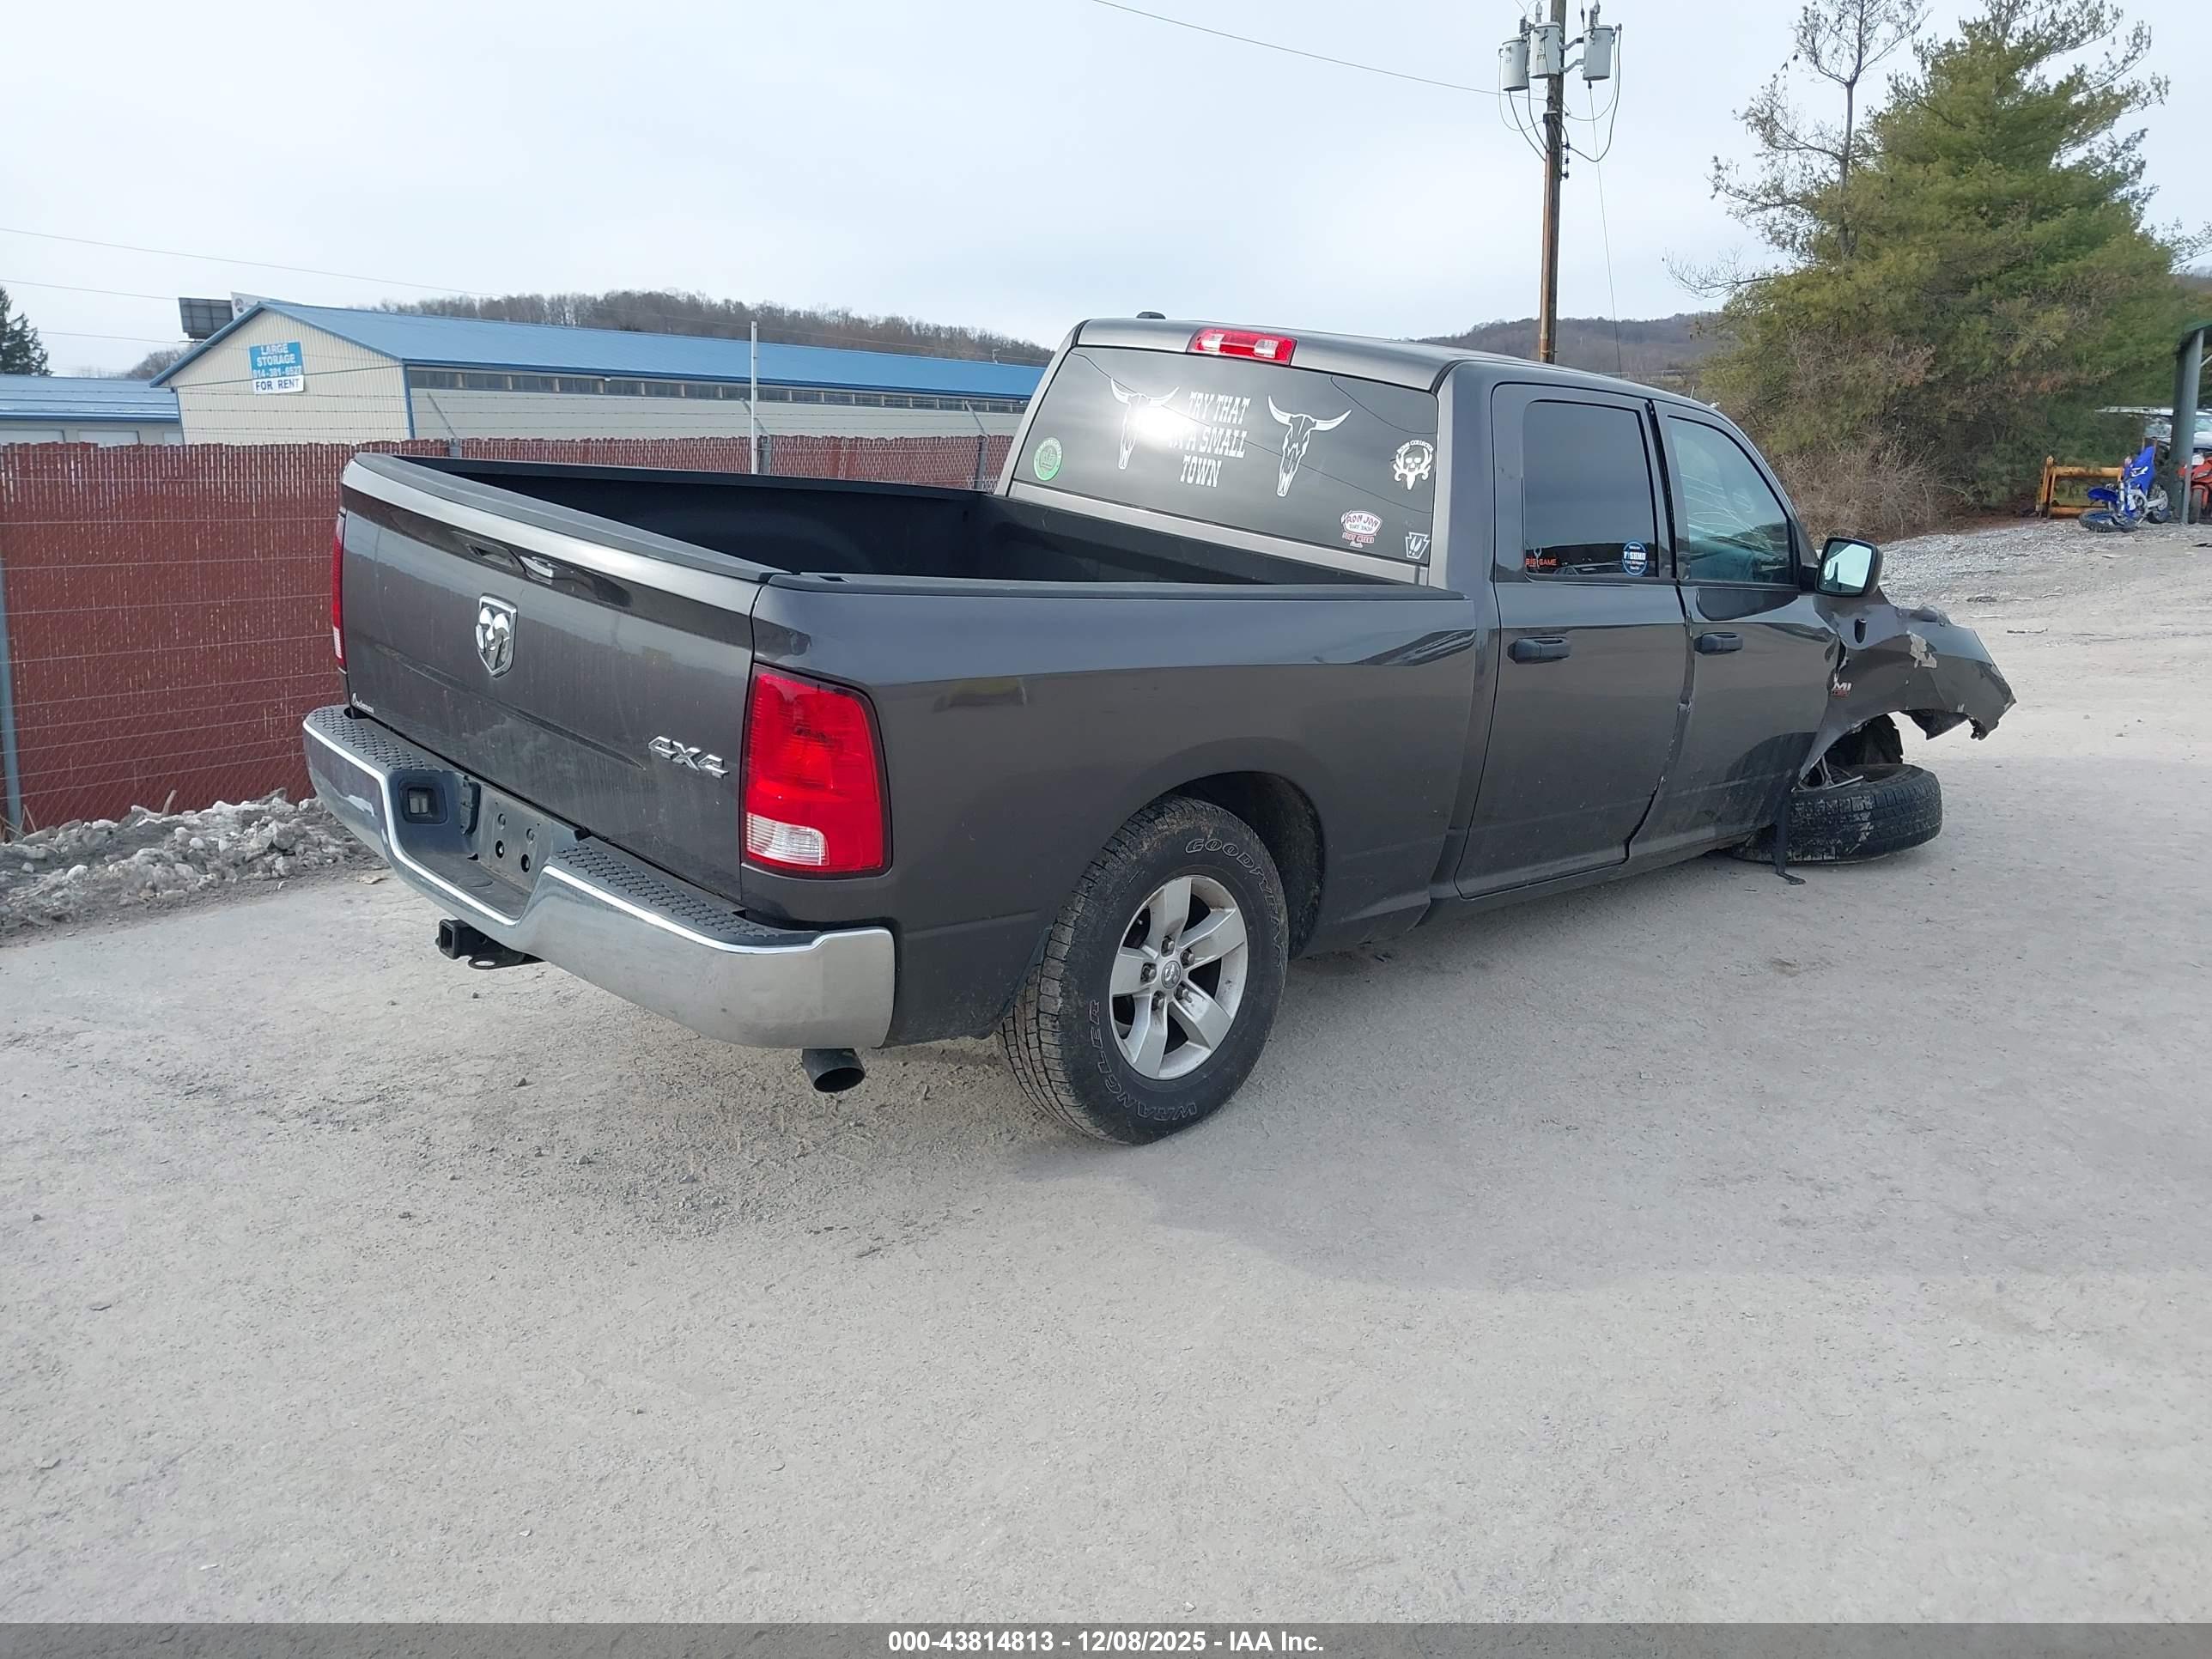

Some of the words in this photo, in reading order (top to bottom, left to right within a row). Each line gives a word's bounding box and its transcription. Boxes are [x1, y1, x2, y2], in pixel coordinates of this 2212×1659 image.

[257, 354, 295, 367] STORAGE
[260, 343, 289, 356] LARGE
[255, 380, 273, 391] FOR
[277, 379, 301, 390] RENT
[1188, 391, 1214, 421] TRY
[1213, 394, 1251, 425] THAT
[1186, 431, 1197, 451] A
[1199, 426, 1248, 459] SMALL
[1180, 454, 1222, 488] TOWN
[1346, 514, 1364, 525] RON
[647, 735, 730, 778] 4X4
[1185, 838, 1286, 975] GOODYEAR
[1089, 999, 1198, 1121] WRANGLER
